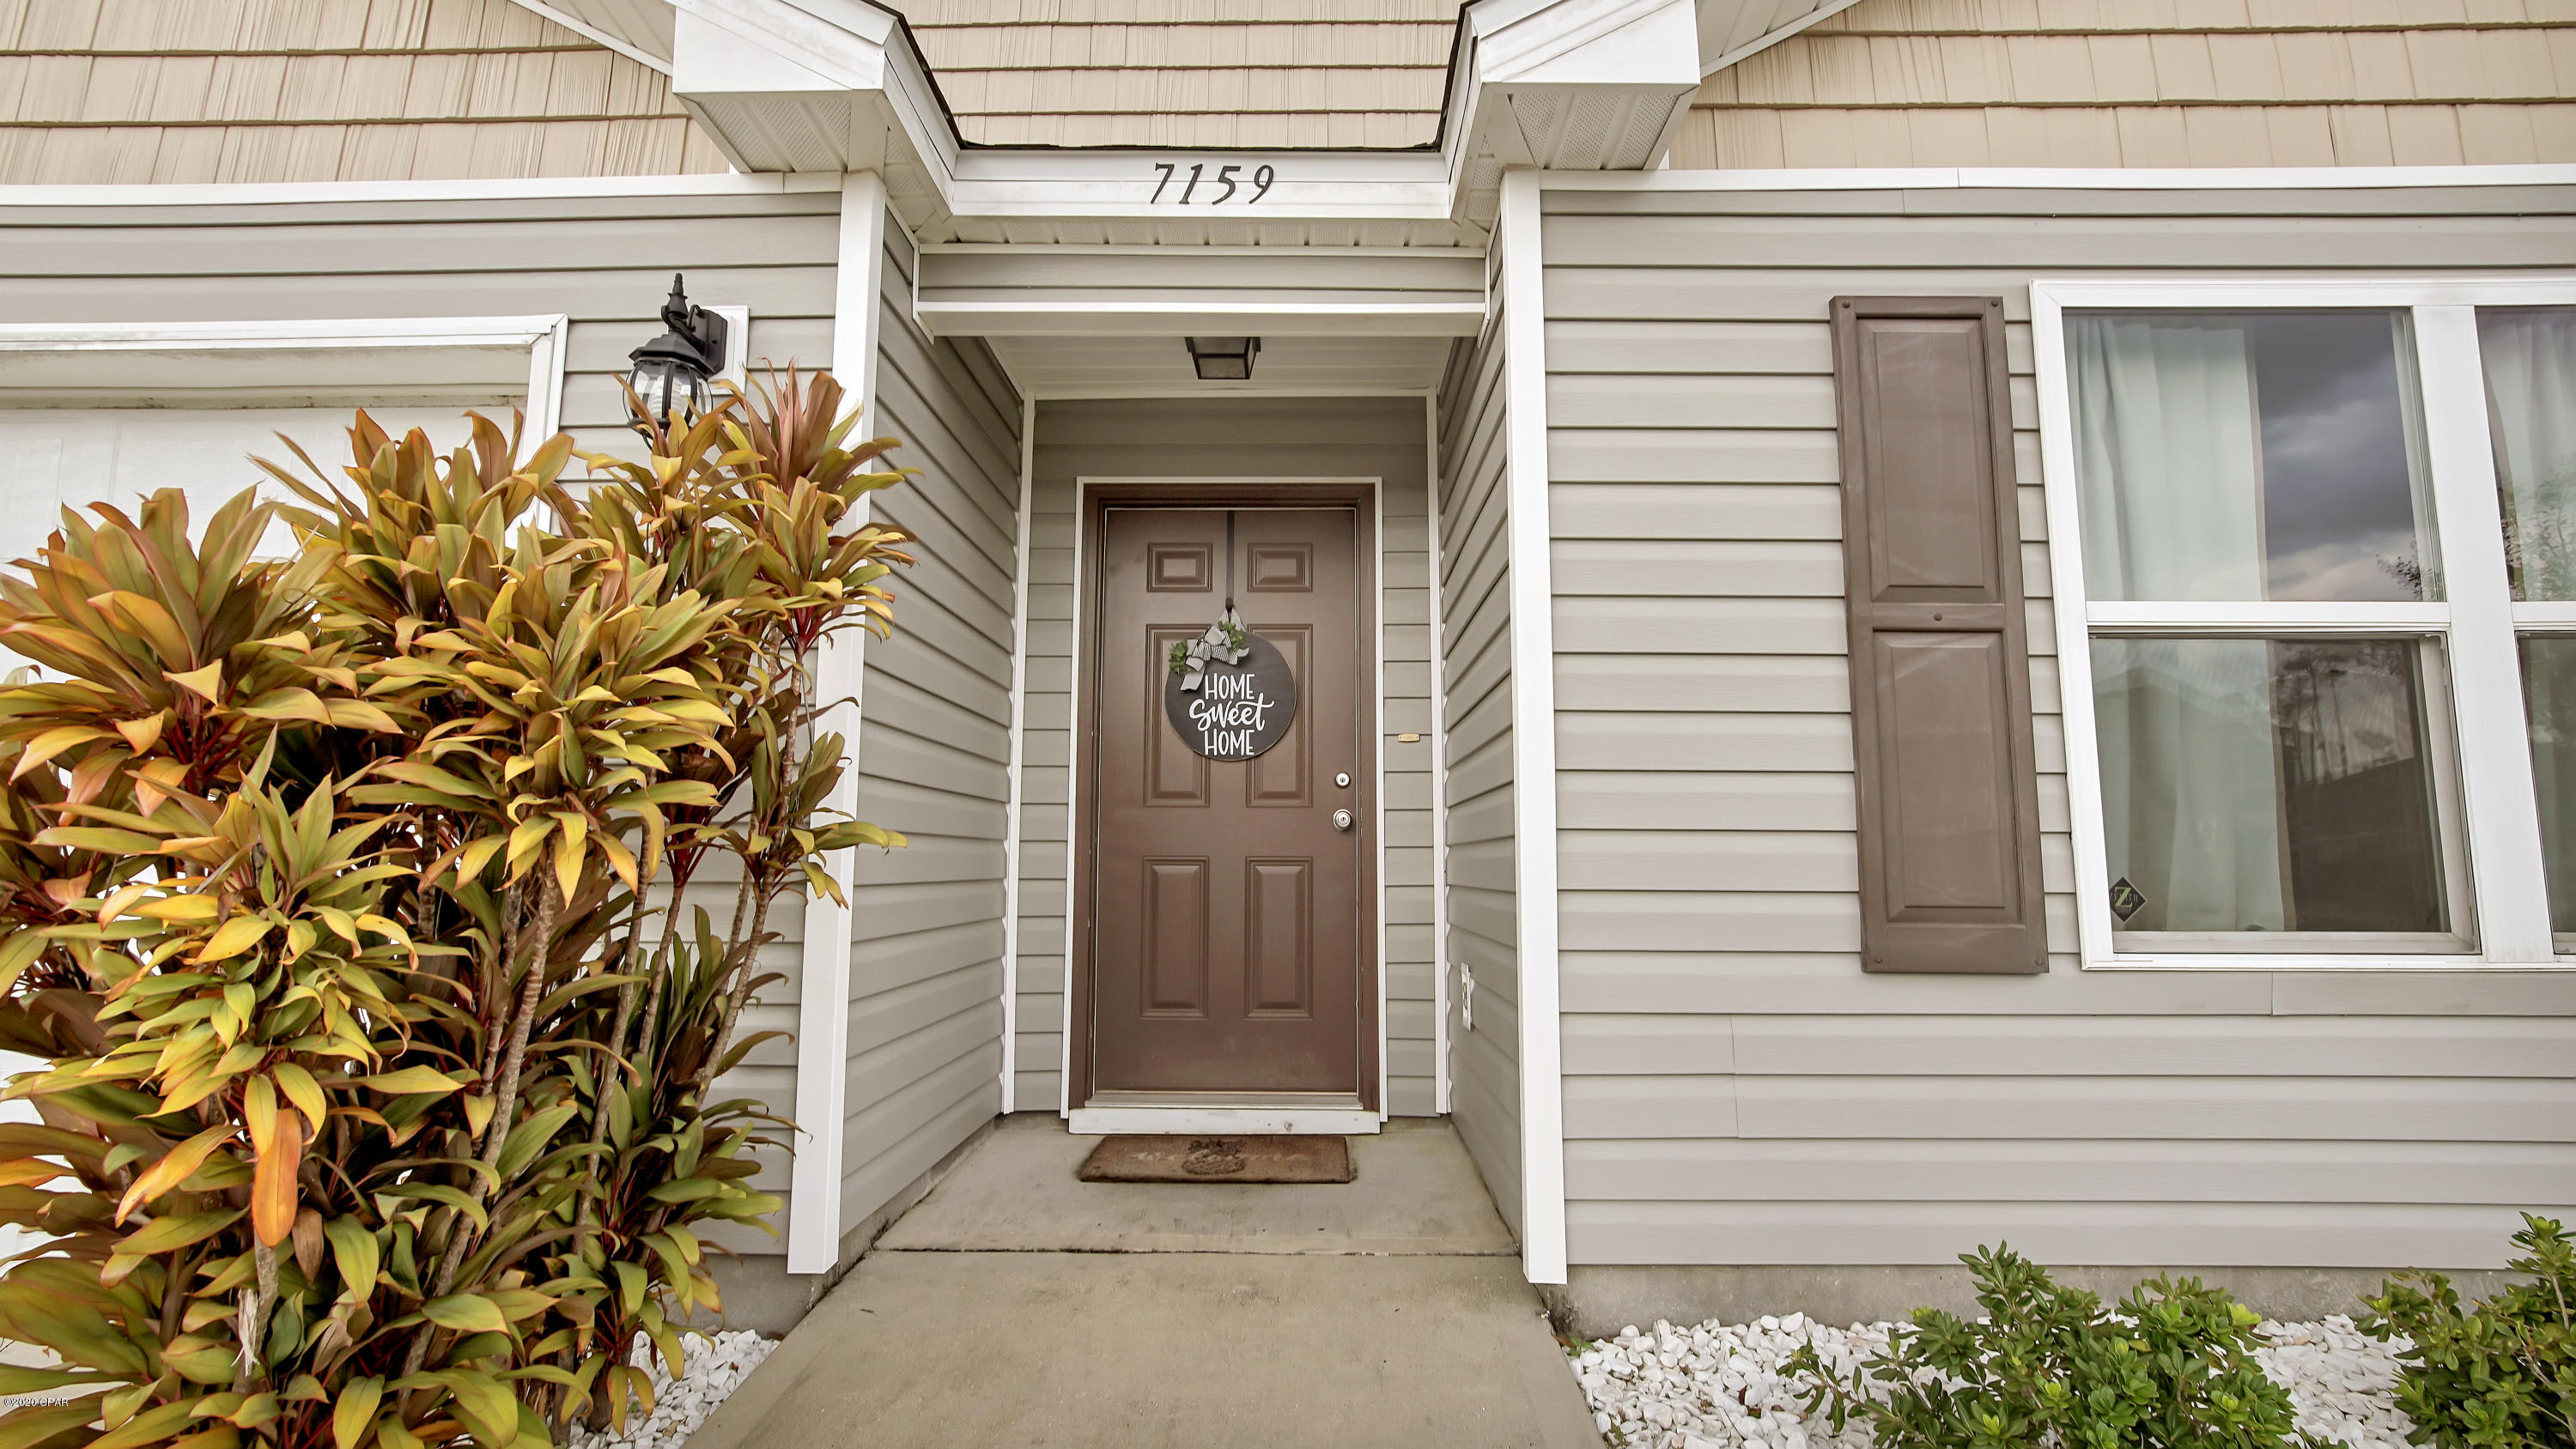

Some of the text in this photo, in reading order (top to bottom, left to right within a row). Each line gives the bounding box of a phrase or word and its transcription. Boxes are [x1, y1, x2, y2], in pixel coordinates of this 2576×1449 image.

[1150, 161, 1274, 205] 7159
[1204, 672, 1255, 700] HOME
[1188, 692, 1275, 731] Sweet
[1204, 728, 1255, 756] HOME
